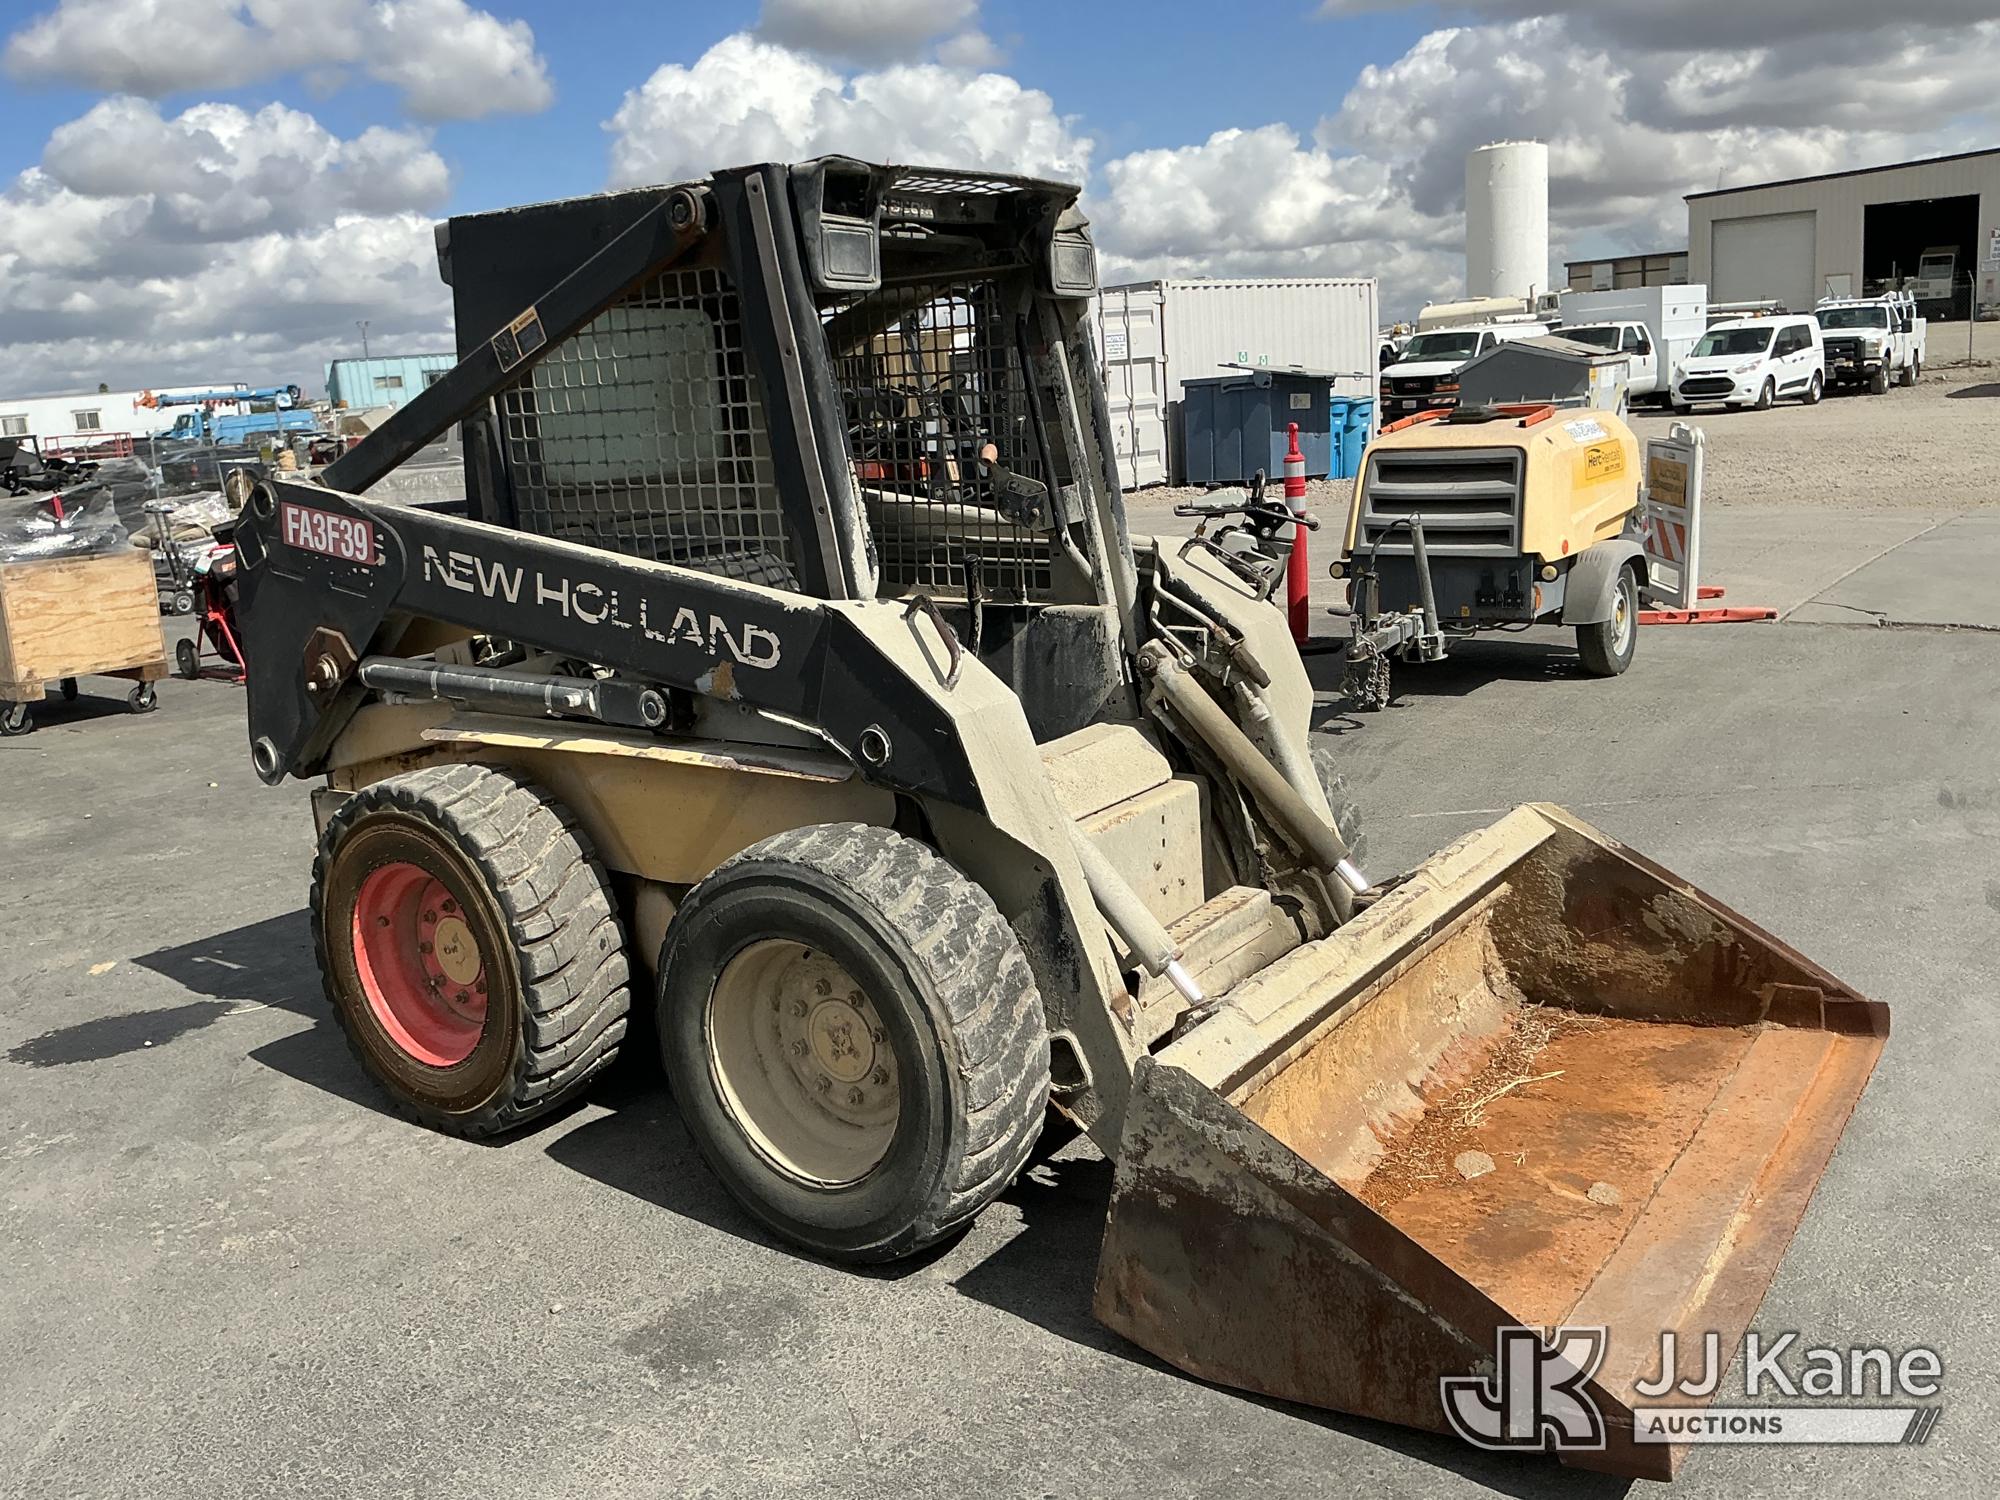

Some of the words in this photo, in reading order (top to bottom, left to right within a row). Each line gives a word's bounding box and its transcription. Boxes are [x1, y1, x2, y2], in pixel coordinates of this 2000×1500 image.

[286, 506, 369, 561] FA3F39
[423, 545, 524, 604] NEW
[535, 572, 781, 669] HOLLAND
